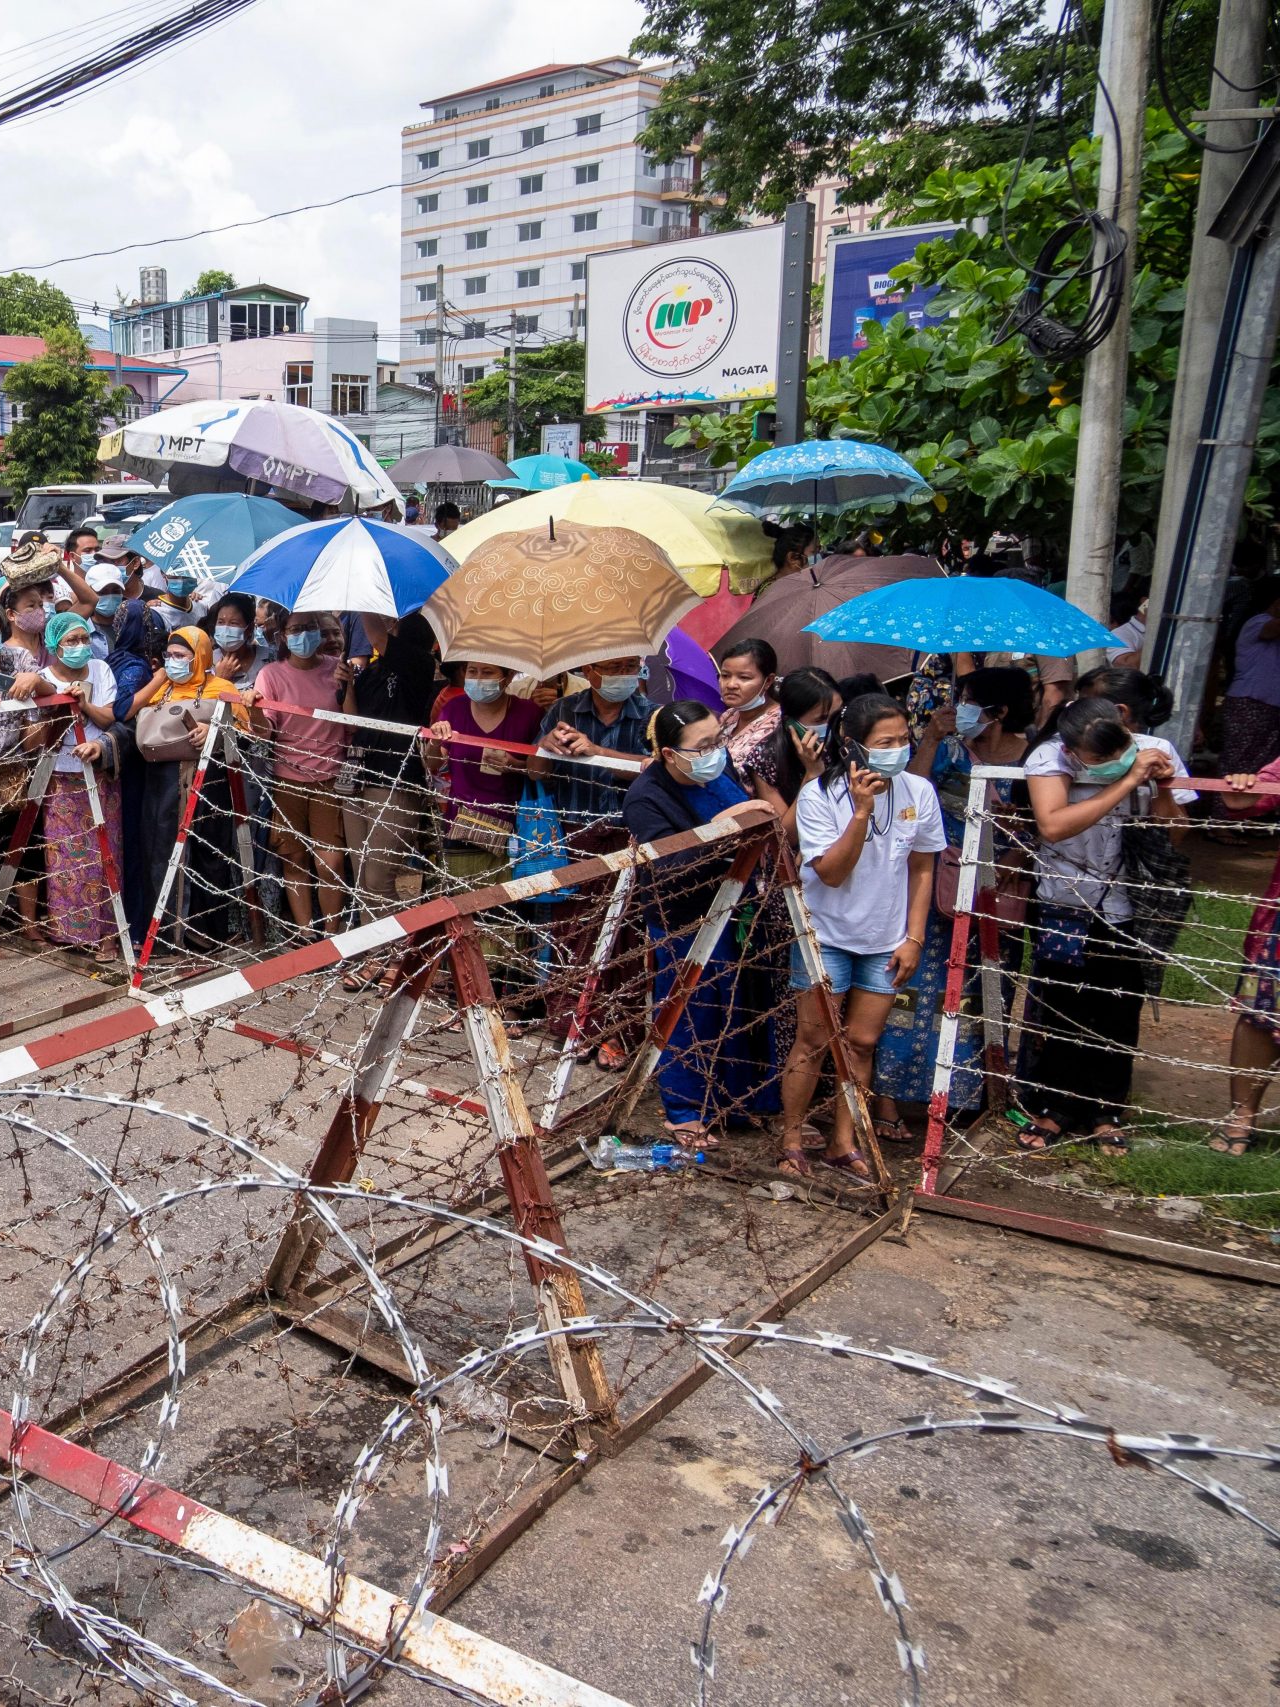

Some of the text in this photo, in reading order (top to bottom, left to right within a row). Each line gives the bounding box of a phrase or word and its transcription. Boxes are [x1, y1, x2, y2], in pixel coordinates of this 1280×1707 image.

[722, 364, 768, 377] NAGATA
[168, 435, 206, 454] MPT
[275, 462, 321, 486] MPT
[148, 531, 174, 553] STUDIO
